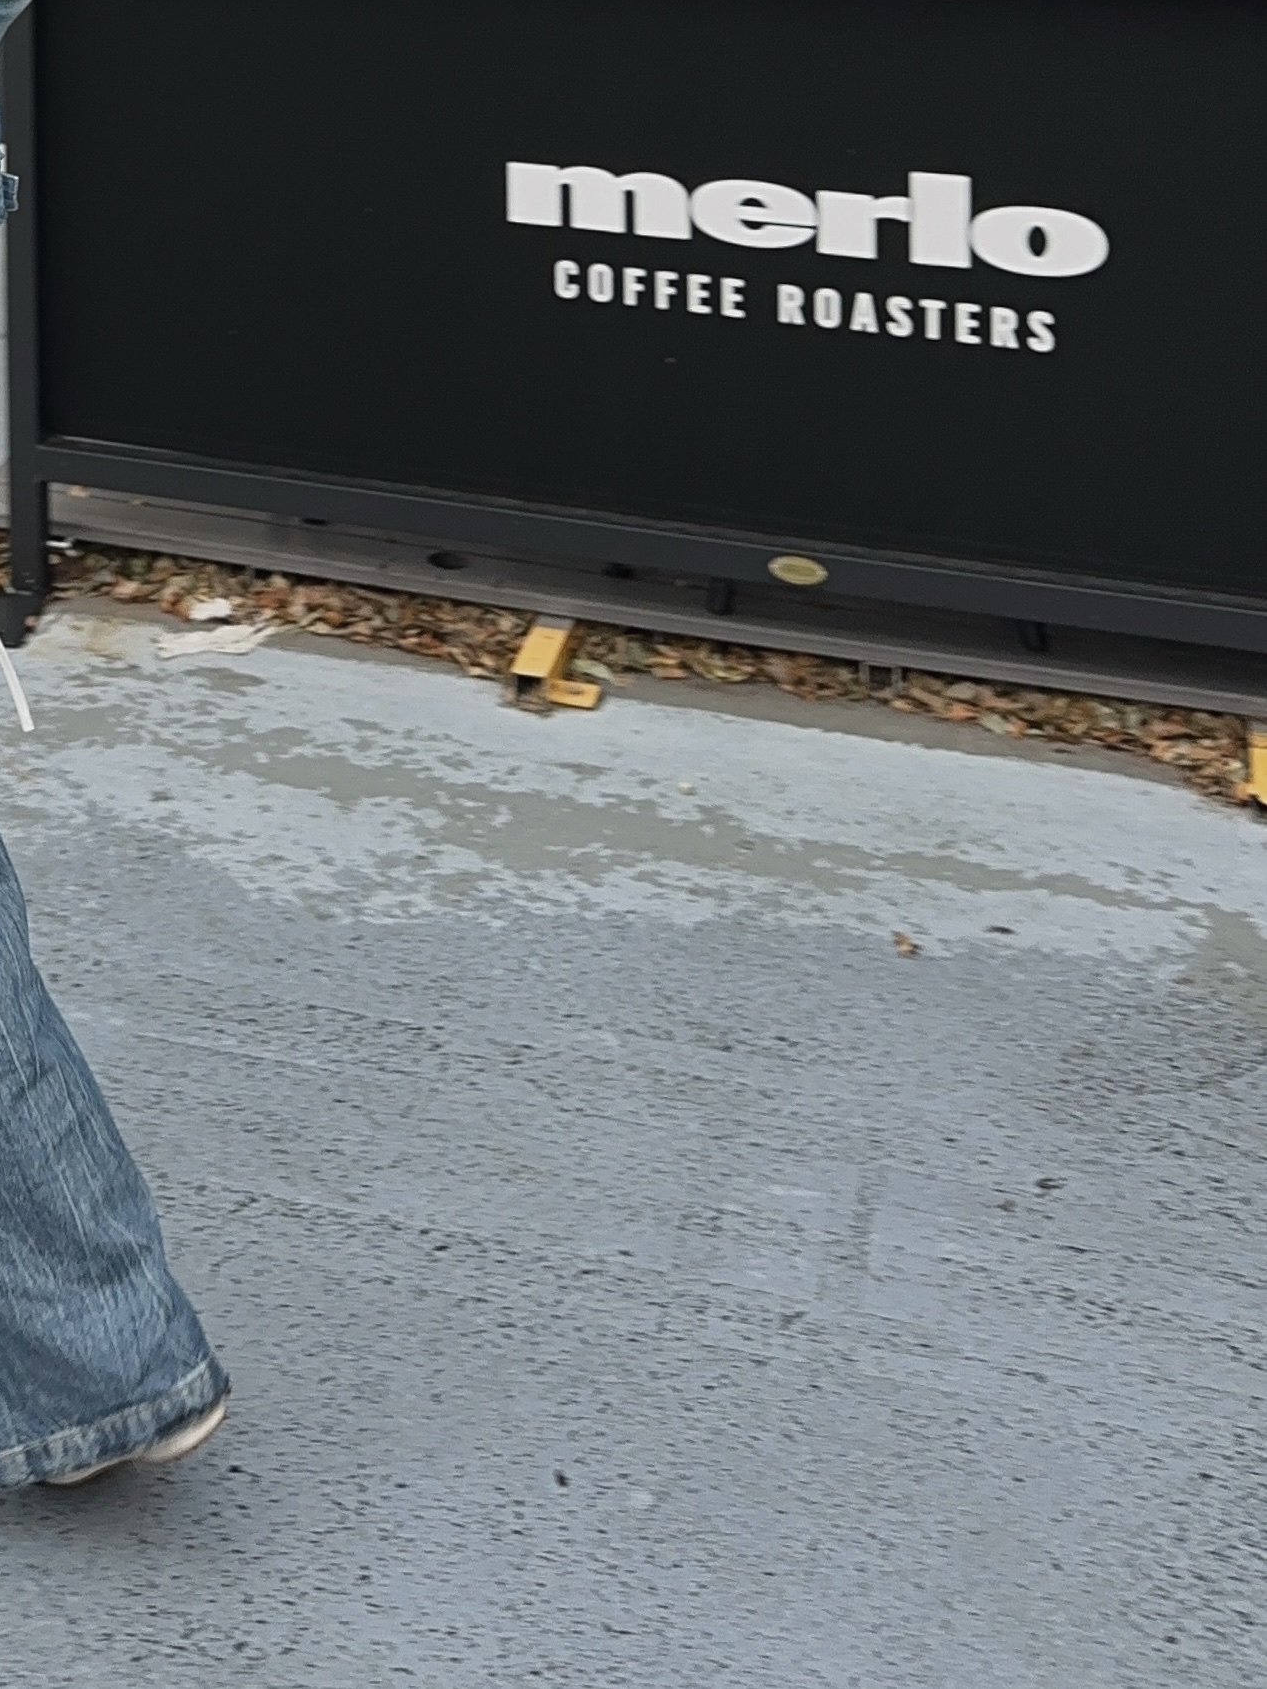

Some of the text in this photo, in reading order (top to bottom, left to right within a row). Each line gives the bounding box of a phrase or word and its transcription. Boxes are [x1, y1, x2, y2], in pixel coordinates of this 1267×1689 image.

[505, 161, 1110, 278] merlo
[553, 259, 1056, 353] COFFEE ROASTERS
